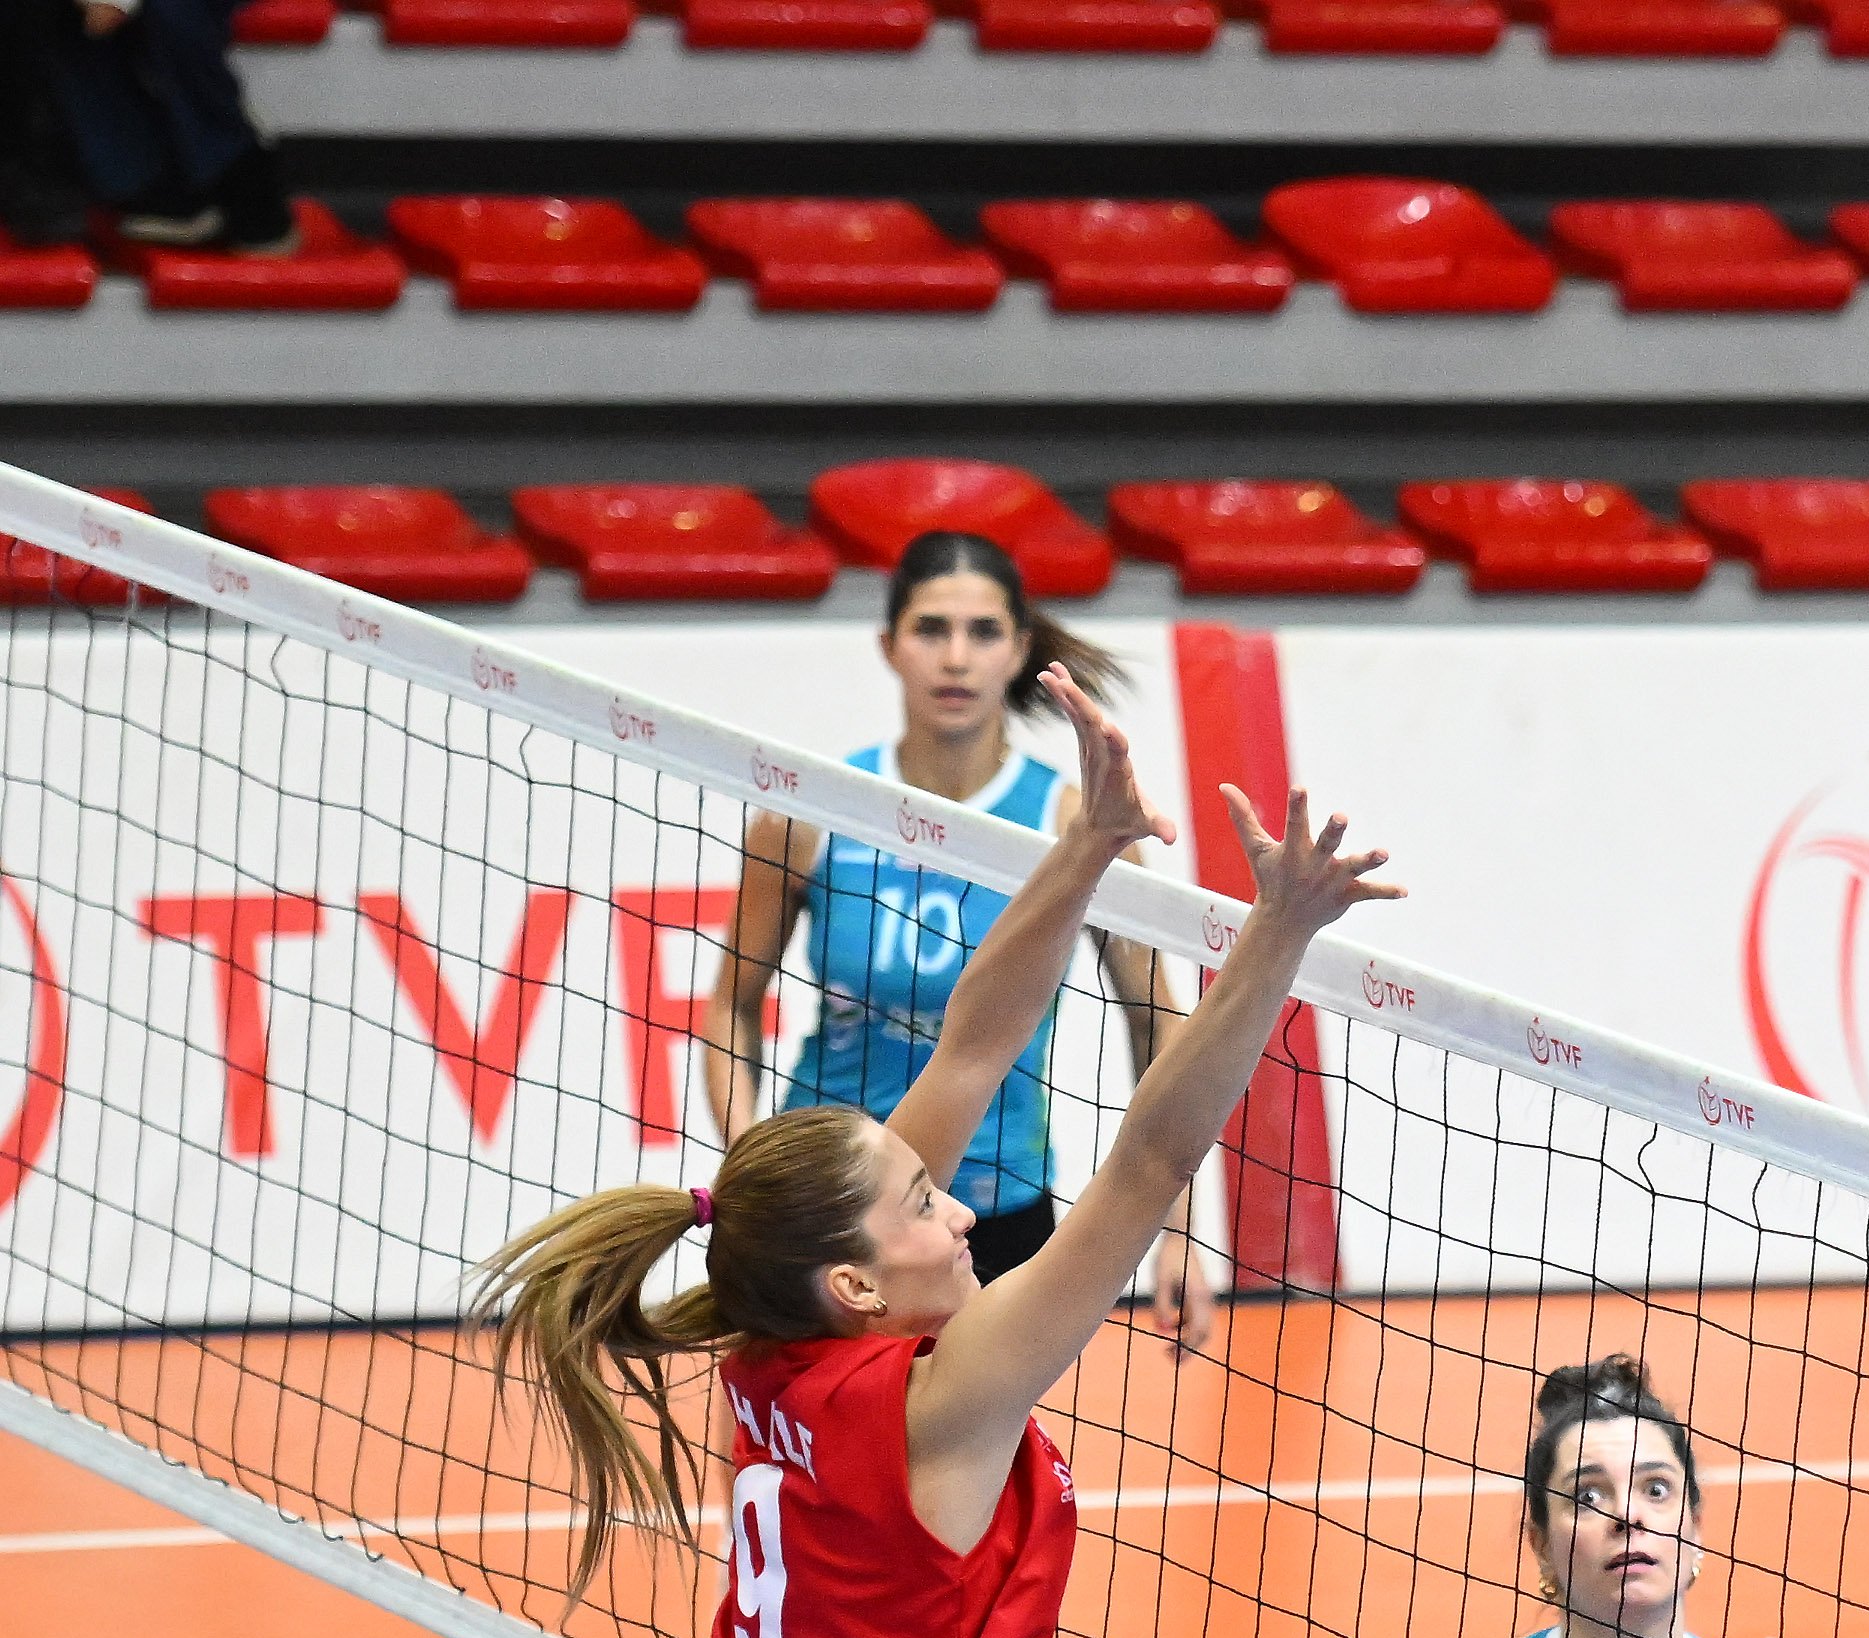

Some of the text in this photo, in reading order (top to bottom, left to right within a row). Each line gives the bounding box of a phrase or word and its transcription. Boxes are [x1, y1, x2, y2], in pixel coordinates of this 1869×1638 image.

[491, 667, 517, 693] TVF
[629, 715, 656, 743] TVF
[771, 765, 799, 793] TVF
[918, 818, 946, 844] TVF
[872, 886, 963, 975] 10
[1385, 981, 1416, 1011] TVF
[137, 886, 781, 1158] TVF
[1550, 1038, 1582, 1069] TVF
[1723, 1098, 1754, 1129] TVF
